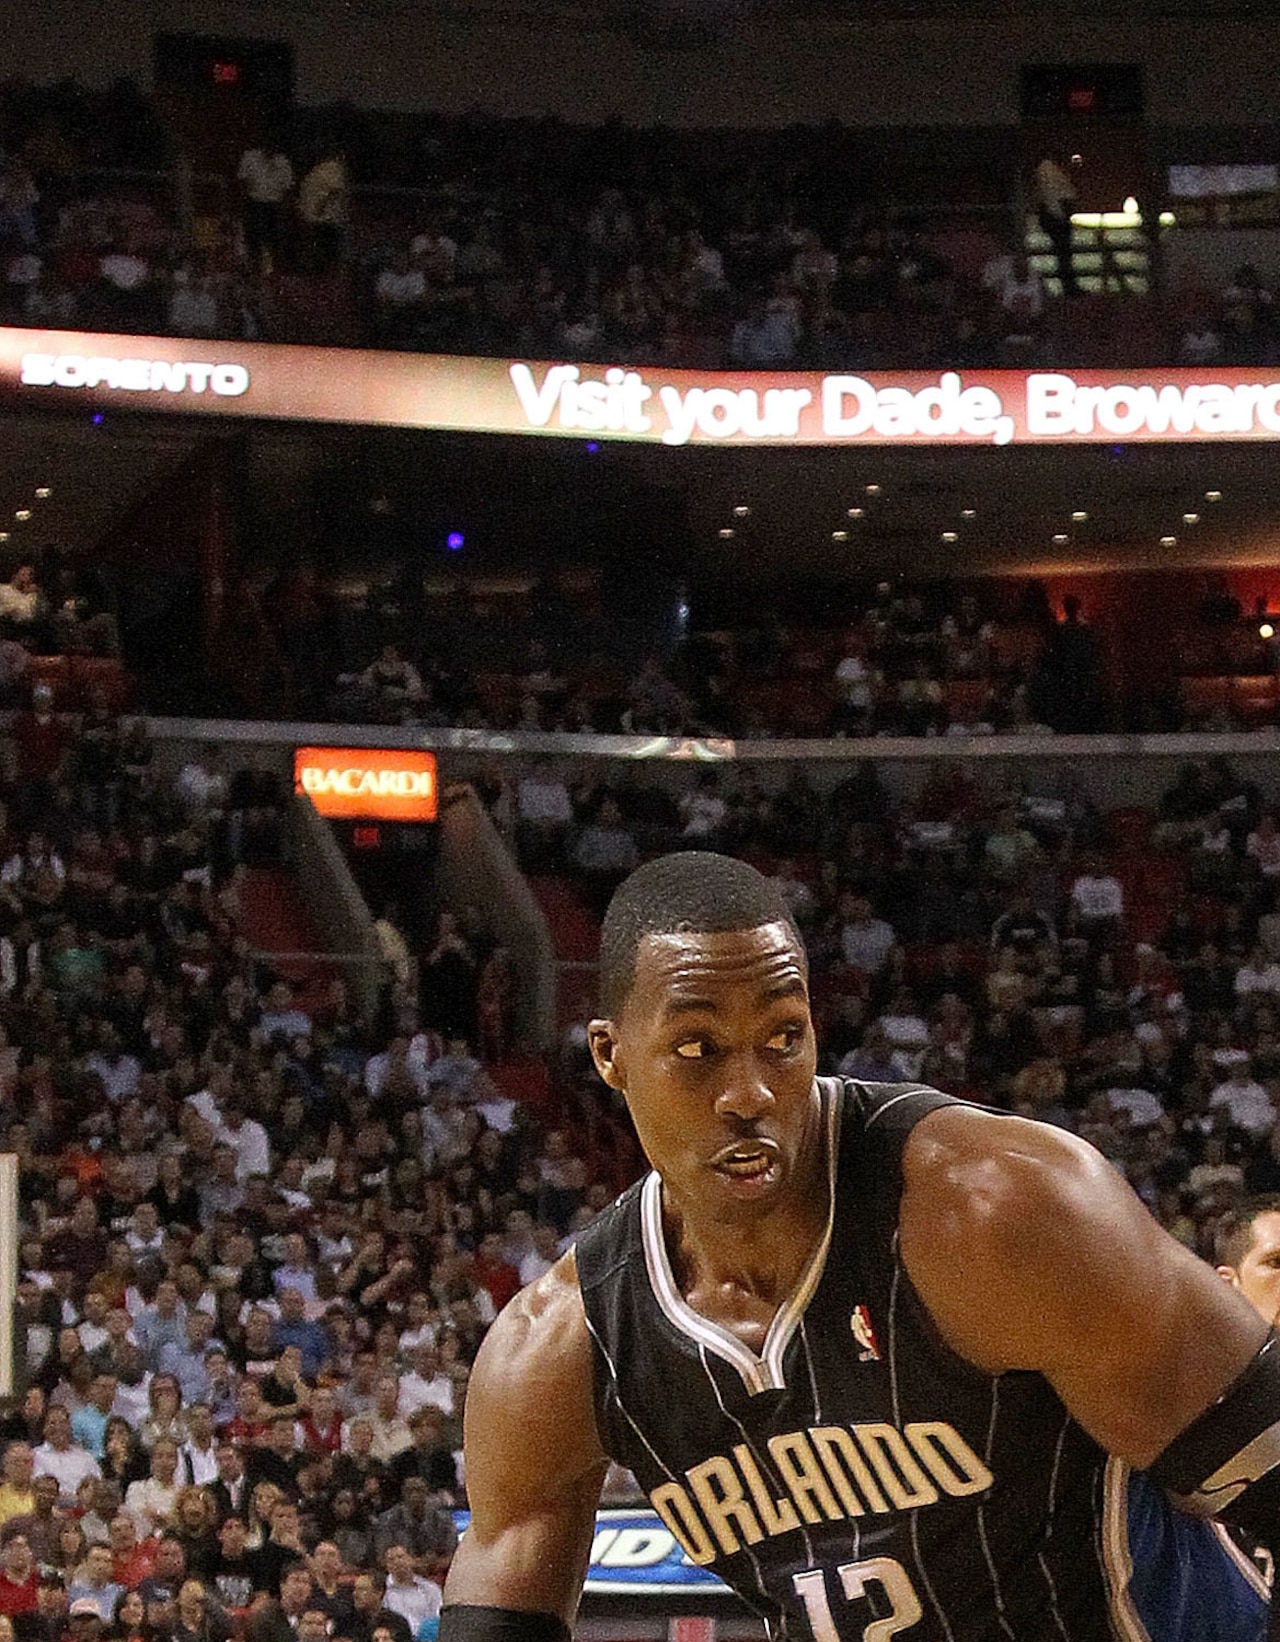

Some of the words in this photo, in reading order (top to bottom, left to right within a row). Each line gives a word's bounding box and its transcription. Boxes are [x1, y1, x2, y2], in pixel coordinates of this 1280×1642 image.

[509, 363, 651, 433] Visit
[659, 386, 812, 445] your
[821, 372, 1013, 445] Dade,
[302, 767, 432, 796] BACARDI
[649, 1421, 994, 1566] ORLANDO
